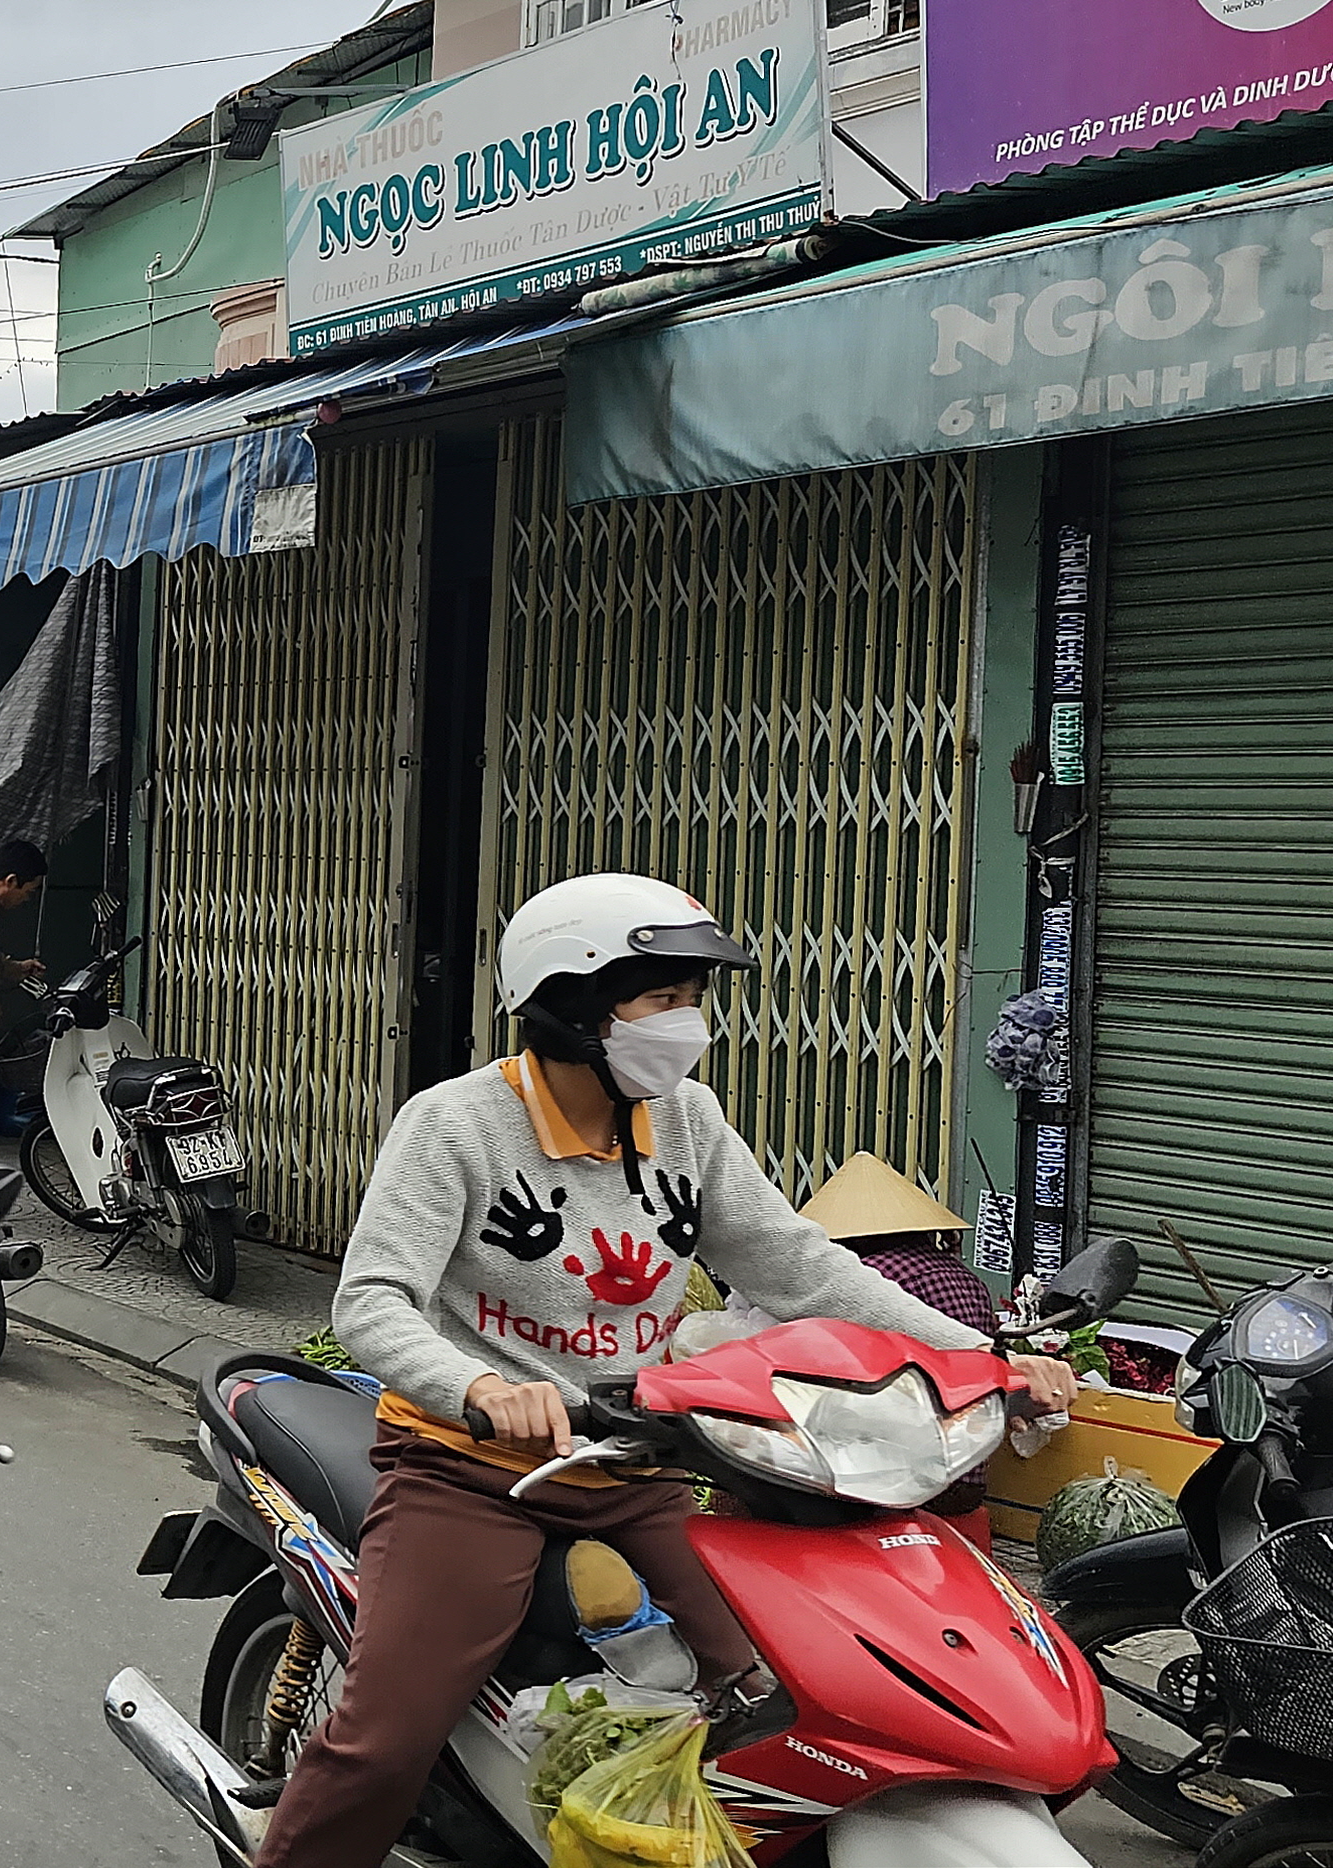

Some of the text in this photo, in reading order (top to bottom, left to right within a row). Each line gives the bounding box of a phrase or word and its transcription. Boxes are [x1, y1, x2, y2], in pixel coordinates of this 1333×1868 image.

[299, 103, 443, 189] NHÀ THUỐC
[317, 47, 780, 258] NGỌC LINH HỘI AN
[995, 131, 1064, 163] PHÒNG
[1069, 118, 1105, 146] TẬP
[1109, 100, 1151, 137] THỂ
[1151, 97, 1196, 128] DỤC
[1200, 86, 1228, 114] VÀ
[1232, 74, 1289, 107] DINH
[312, 272, 379, 303] Chuyên
[386, 260, 422, 286] Bán
[460, 225, 523, 265] Thuốc
[530, 218, 567, 247] Tân
[576, 198, 632, 232] Dược
[652, 184, 691, 220] Vật
[736, 161, 755, 188] Y
[758, 146, 792, 181] Tế
[297, 333, 315, 351] ĐC:
[316, 329, 327, 345] 61
[418, 300, 438, 321] TÂN
[461, 290, 480, 314] HỘI
[483, 286, 498, 303] AN
[543, 267, 572, 291] 0934
[574, 262, 596, 283] 797
[599, 255, 622, 277] 553
[735, 219, 757, 241] THỊ
[758, 212, 784, 234] THU
[930, 238, 1271, 377] NGÔI
[937, 393, 1007, 437] 61
[1034, 360, 1209, 424] ĐINH
[477, 1292, 619, 1359] Hands
[785, 1735, 869, 1781] HONDA
